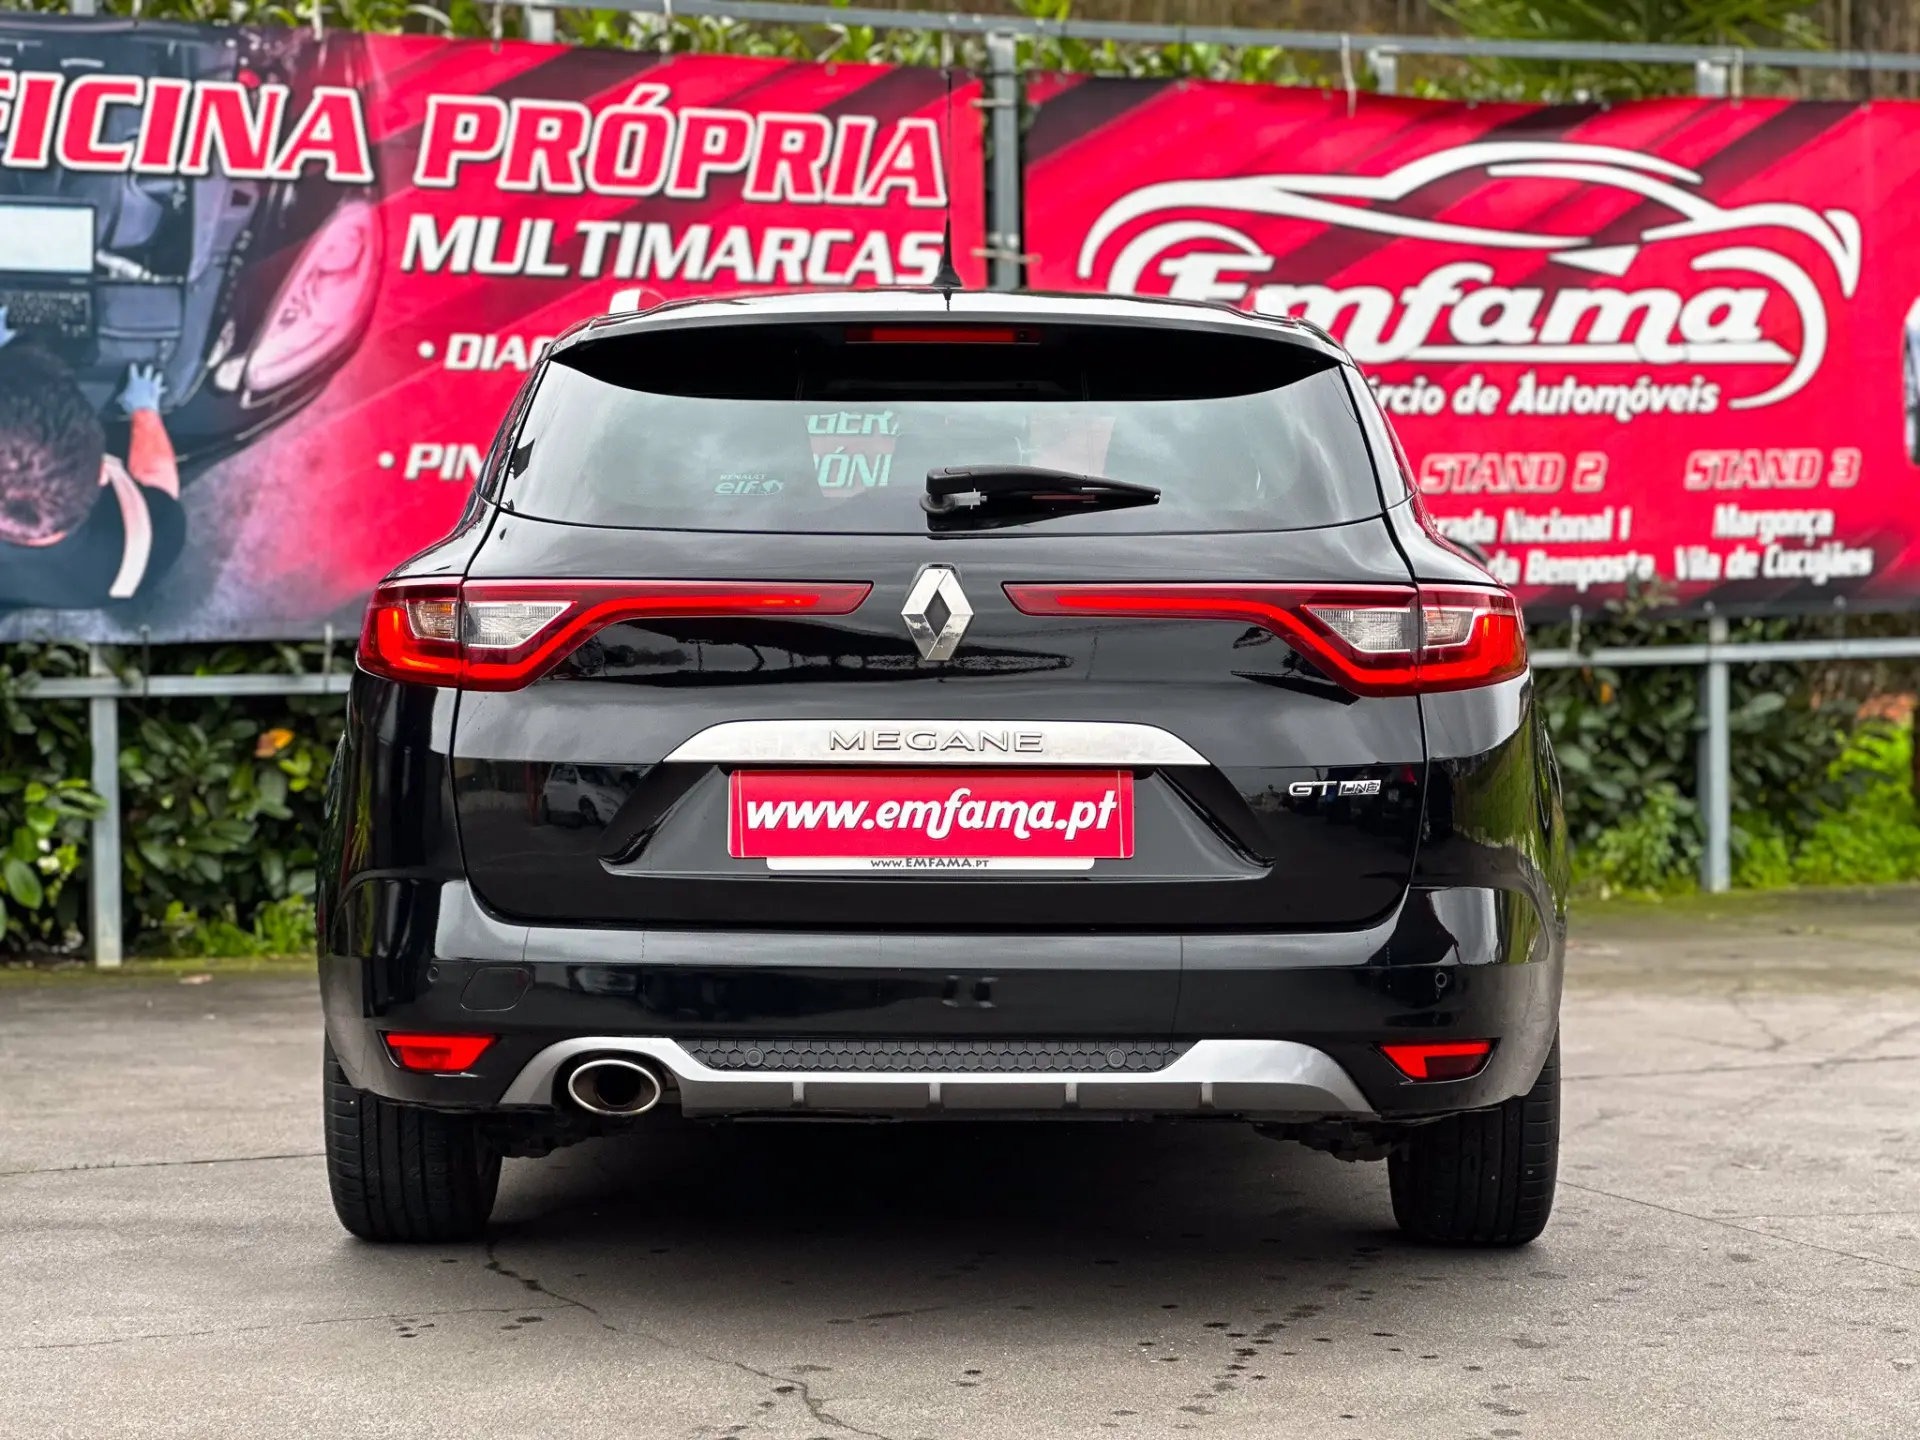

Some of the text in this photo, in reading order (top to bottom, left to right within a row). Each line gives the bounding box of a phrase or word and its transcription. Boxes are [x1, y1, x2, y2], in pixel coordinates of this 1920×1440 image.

[414, 83, 948, 207] PRÓPRIA
[401, 213, 947, 285] MULTIMARCAS
[1367, 368, 1721, 424] rcio de Automóveis
[714, 480, 759, 494] elf
[1419, 451, 1609, 494] STAND 2
[1684, 447, 1862, 491] STAND 3
[1502, 506, 1614, 544] Nacional
[828, 729, 1044, 753] MEGANE
[1288, 780, 1337, 797] GT
[746, 788, 1119, 841] www.emfama.pt
